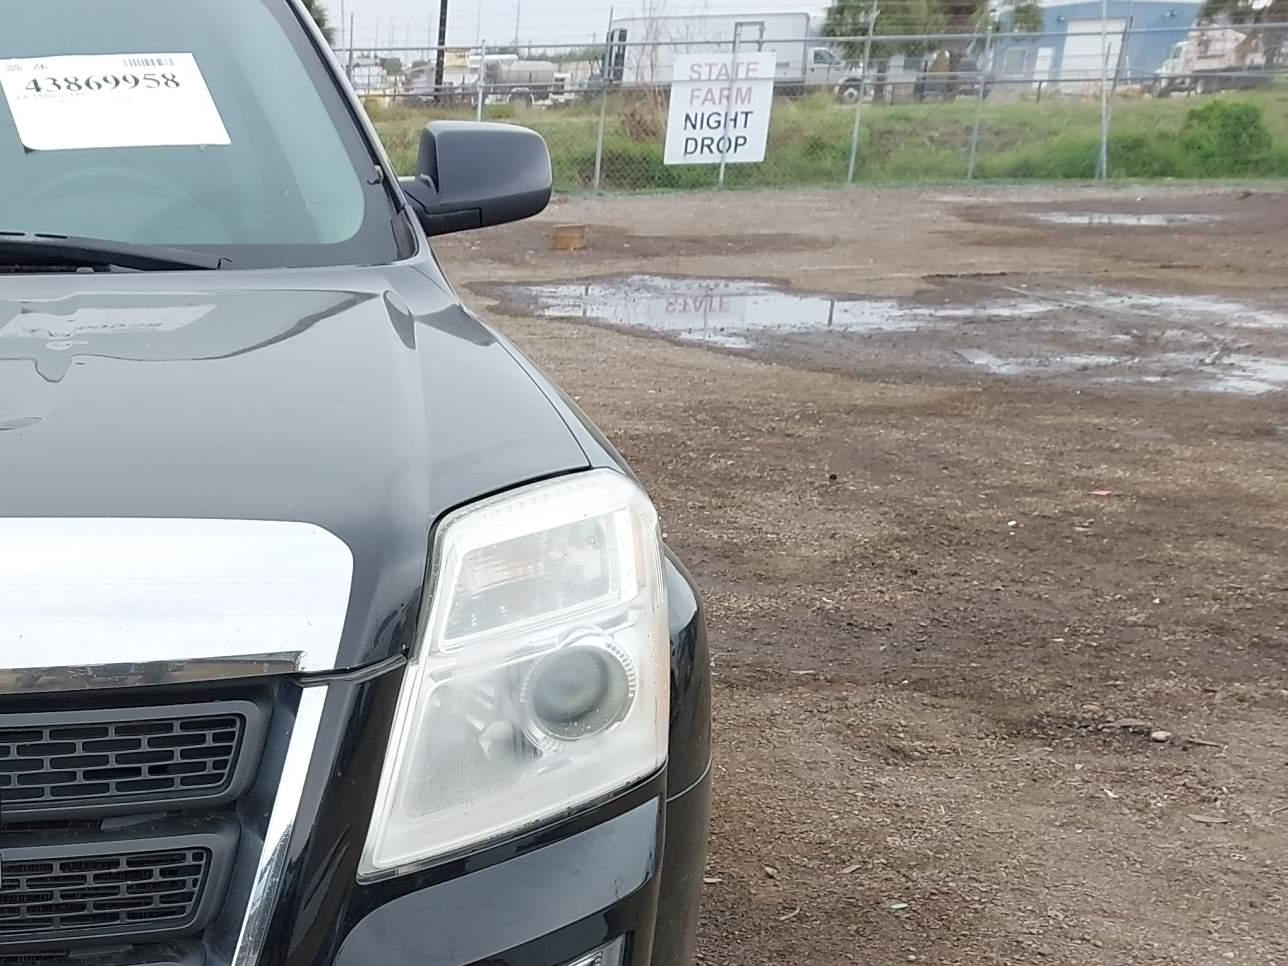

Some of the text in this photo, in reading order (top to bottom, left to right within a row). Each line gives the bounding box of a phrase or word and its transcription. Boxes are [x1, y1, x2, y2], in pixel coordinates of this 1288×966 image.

[688, 61, 760, 80] STATE
[24, 72, 181, 93] 43869958
[689, 86, 753, 106] FARM
[683, 110, 754, 131] NIGHT
[683, 135, 748, 156] DROP
